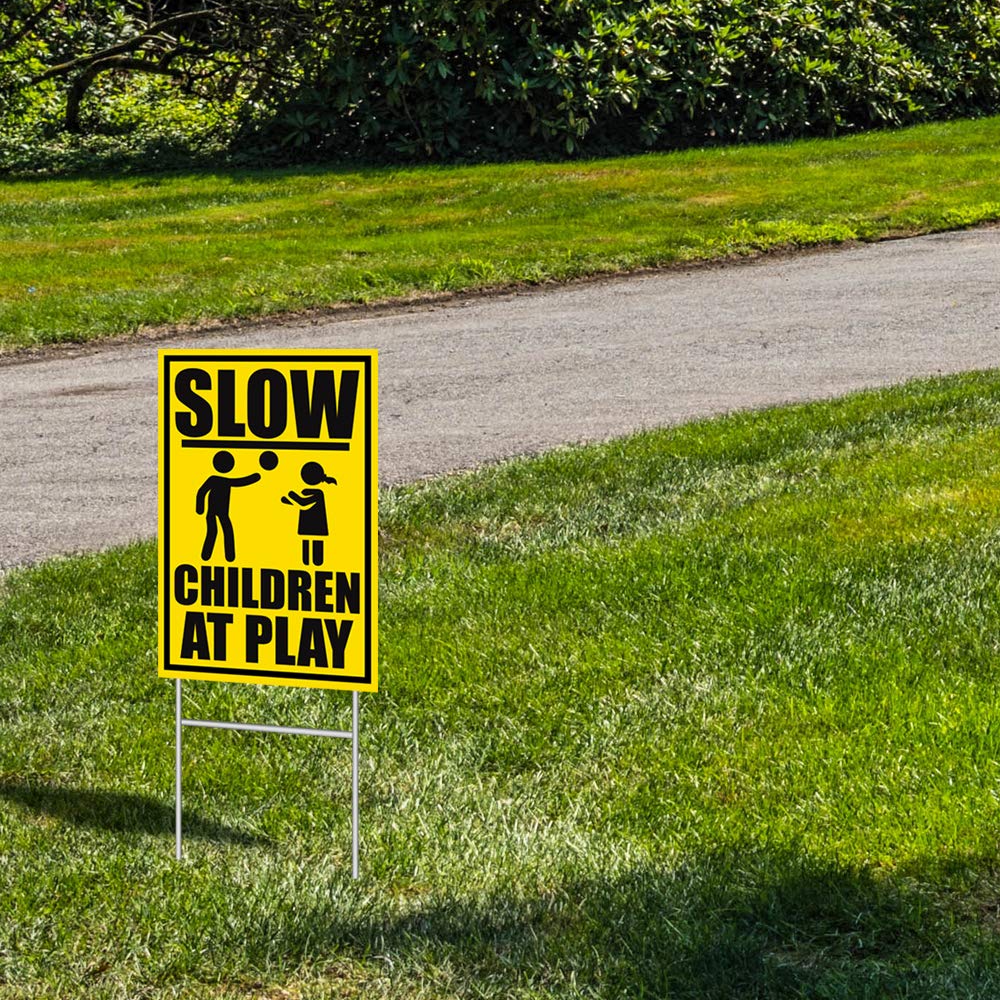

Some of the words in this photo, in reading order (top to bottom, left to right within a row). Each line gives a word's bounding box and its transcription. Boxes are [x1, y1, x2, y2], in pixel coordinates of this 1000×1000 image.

[175, 367, 360, 439] SLOW
[175, 563, 360, 614] CHILDREN
[180, 611, 234, 661] AT
[245, 614, 354, 669] PLAY
